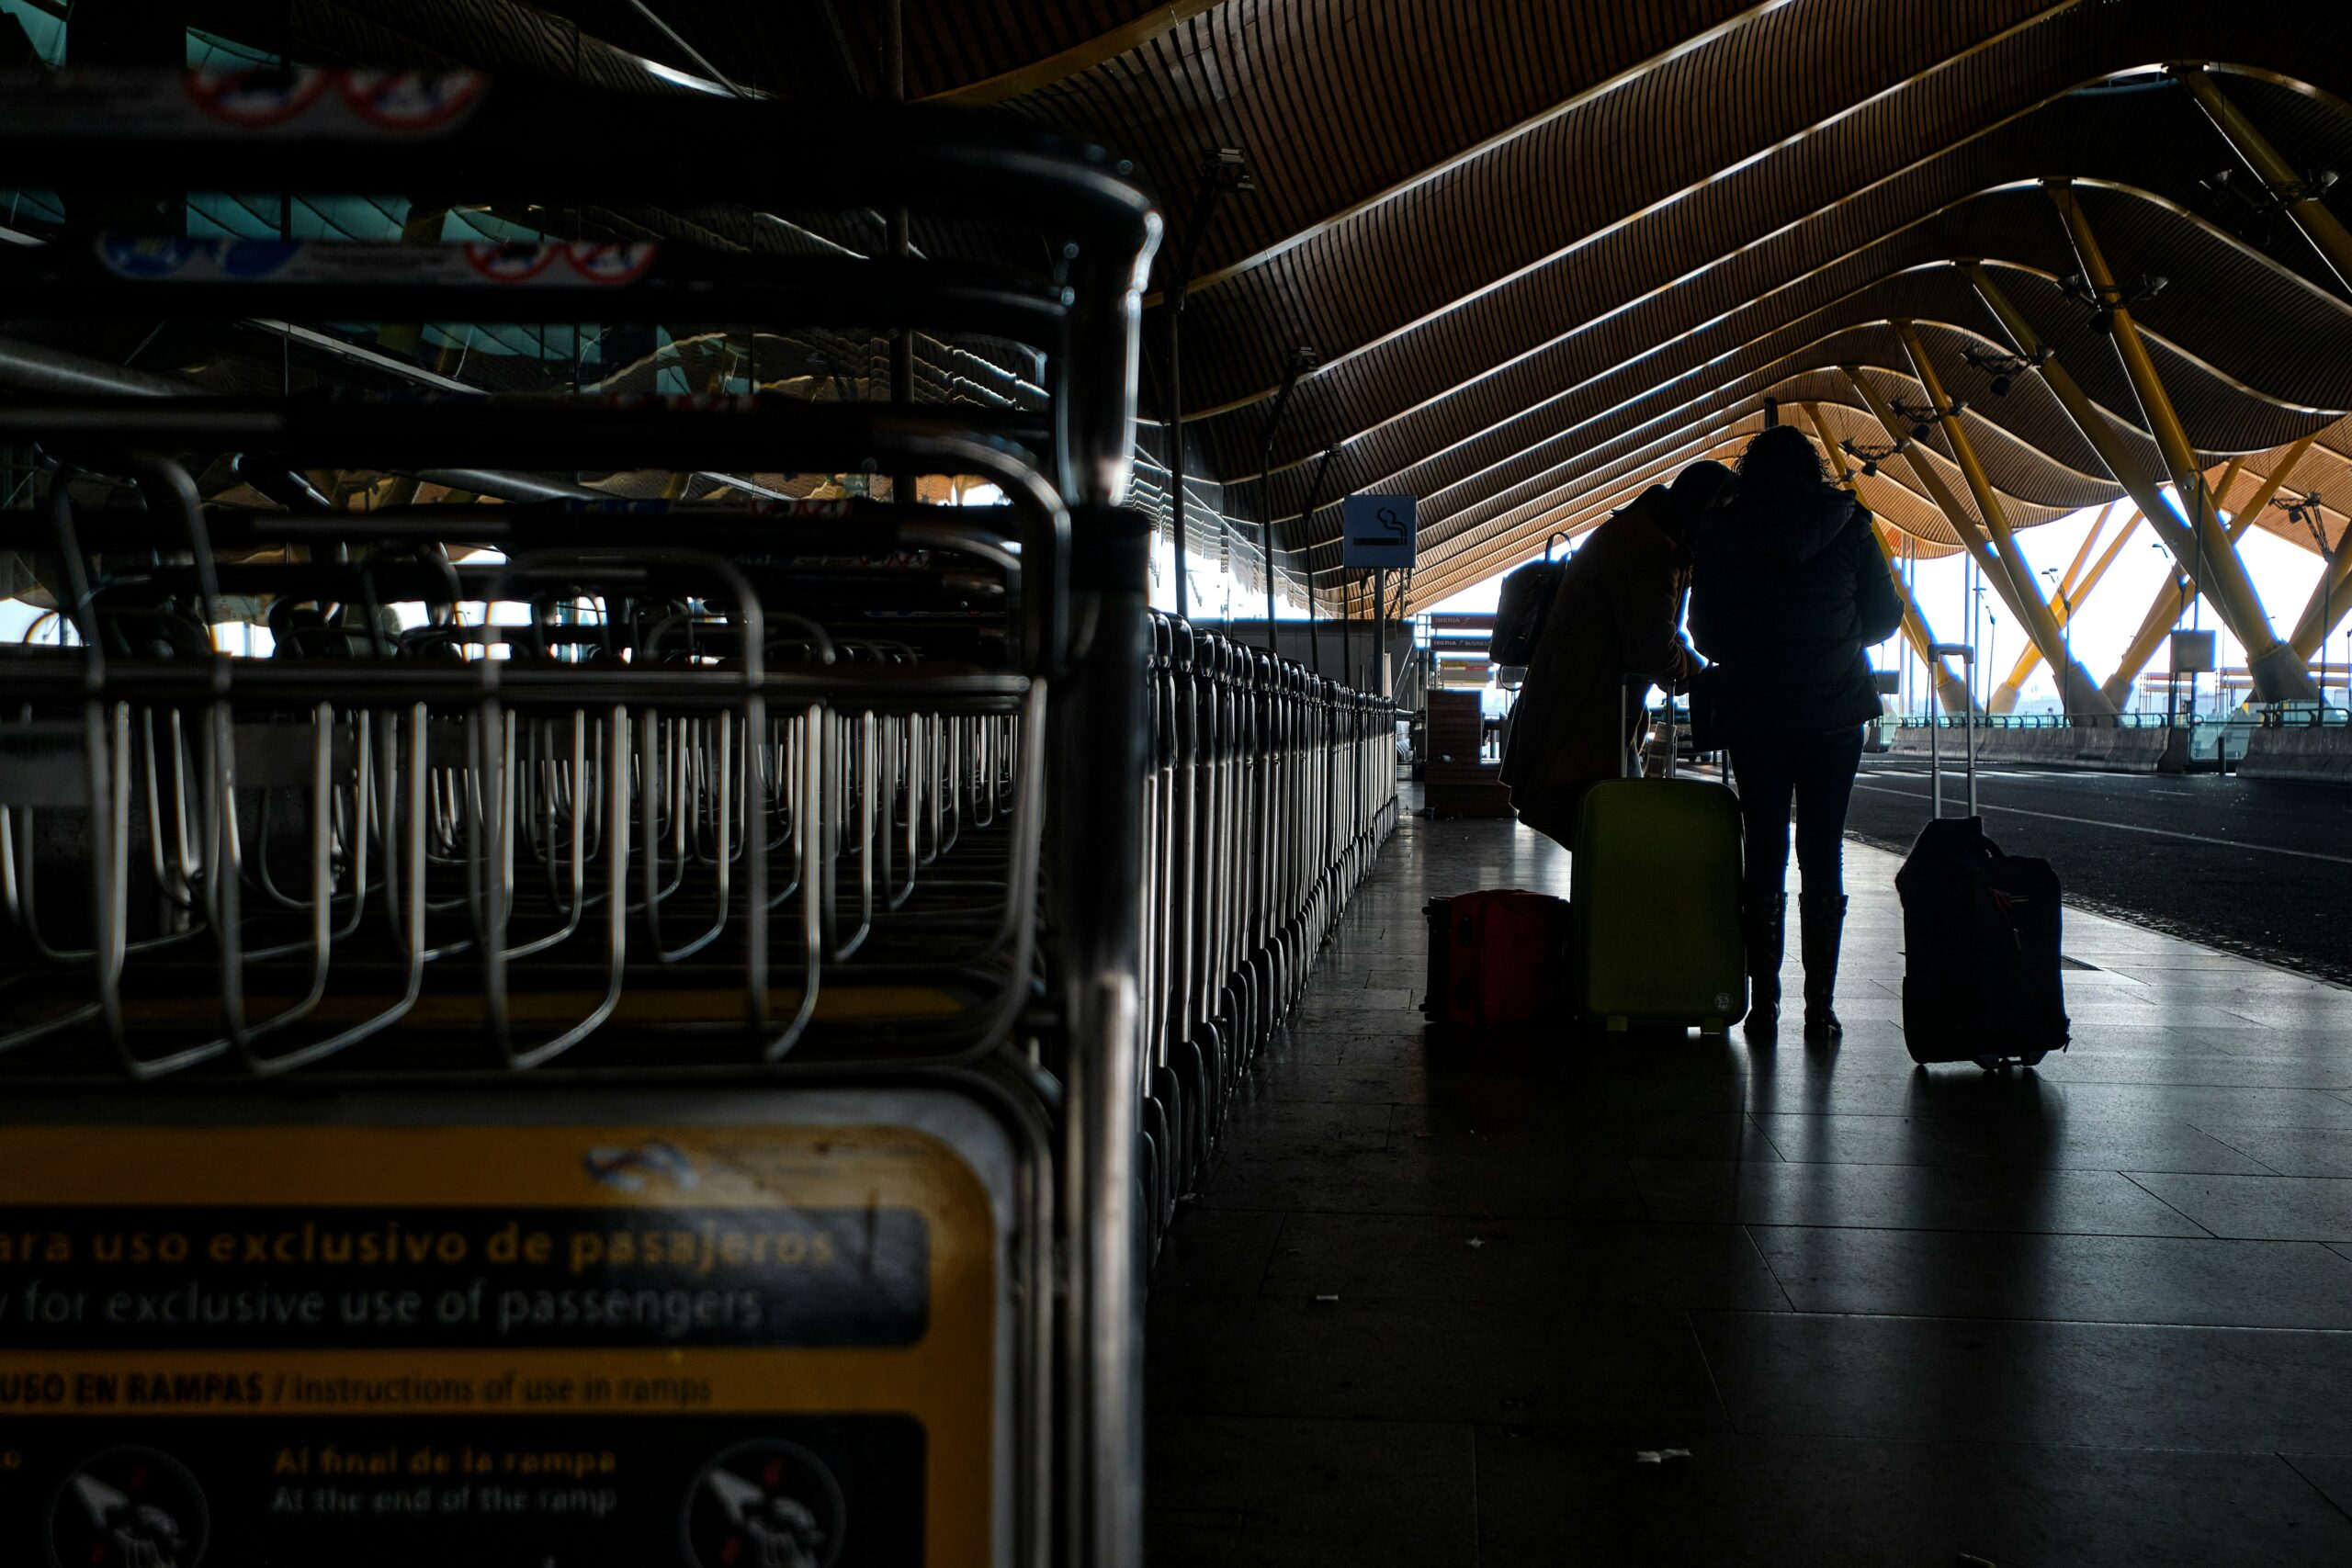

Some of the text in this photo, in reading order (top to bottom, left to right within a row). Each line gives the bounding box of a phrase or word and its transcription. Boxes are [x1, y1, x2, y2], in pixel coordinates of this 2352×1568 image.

[91, 1231, 191, 1265] uso
[207, 1219, 469, 1266] exclusivo
[483, 1219, 554, 1266] de
[567, 1217, 836, 1275] pasajeros
[23, 1278, 92, 1325] for
[102, 1280, 325, 1326] exclusive
[338, 1288, 424, 1326] use
[434, 1277, 490, 1325] of
[497, 1286, 764, 1337] passengers
[1, 1372, 65, 1403] USO
[76, 1372, 120, 1403] EN
[130, 1372, 263, 1404] RAMPAS
[483, 1370, 516, 1404] of
[525, 1377, 571, 1404] use
[582, 1374, 613, 1404] in
[622, 1377, 712, 1409] ramps
[272, 1443, 617, 1482] Al final de la rampa
[311, 1485, 366, 1514] the
[369, 1485, 433, 1514] end
[436, 1482, 472, 1514] of
[476, 1482, 530, 1514] the
[533, 1488, 617, 1519] ramp
